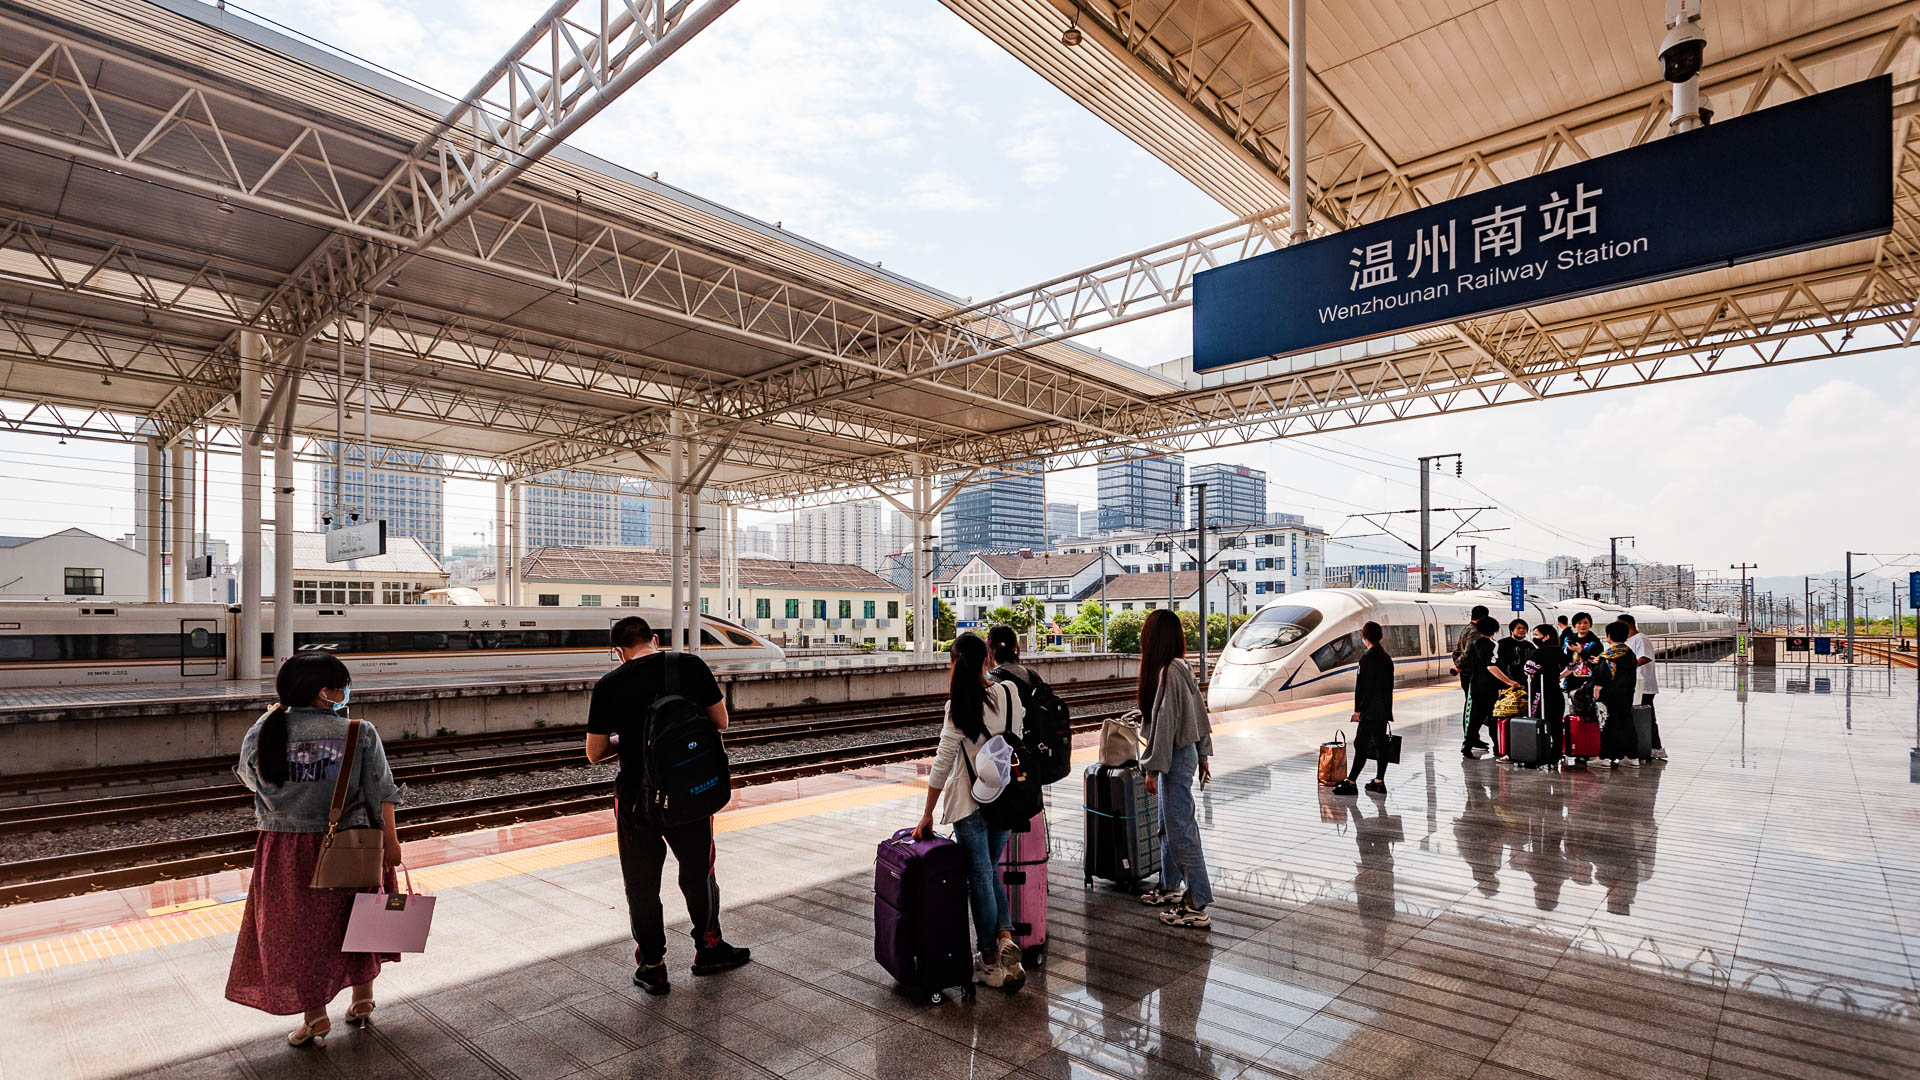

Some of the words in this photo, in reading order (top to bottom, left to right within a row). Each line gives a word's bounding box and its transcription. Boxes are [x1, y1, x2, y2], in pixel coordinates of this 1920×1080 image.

[1348, 182, 1603, 292] 温州南站
[1318, 283, 1449, 324] Wenzhounan
[1457, 260, 1549, 293] Railway
[1557, 237, 1648, 270] Station
[298, 643, 339, 651] CR
[462, 619, 508, 629] 复兴号
